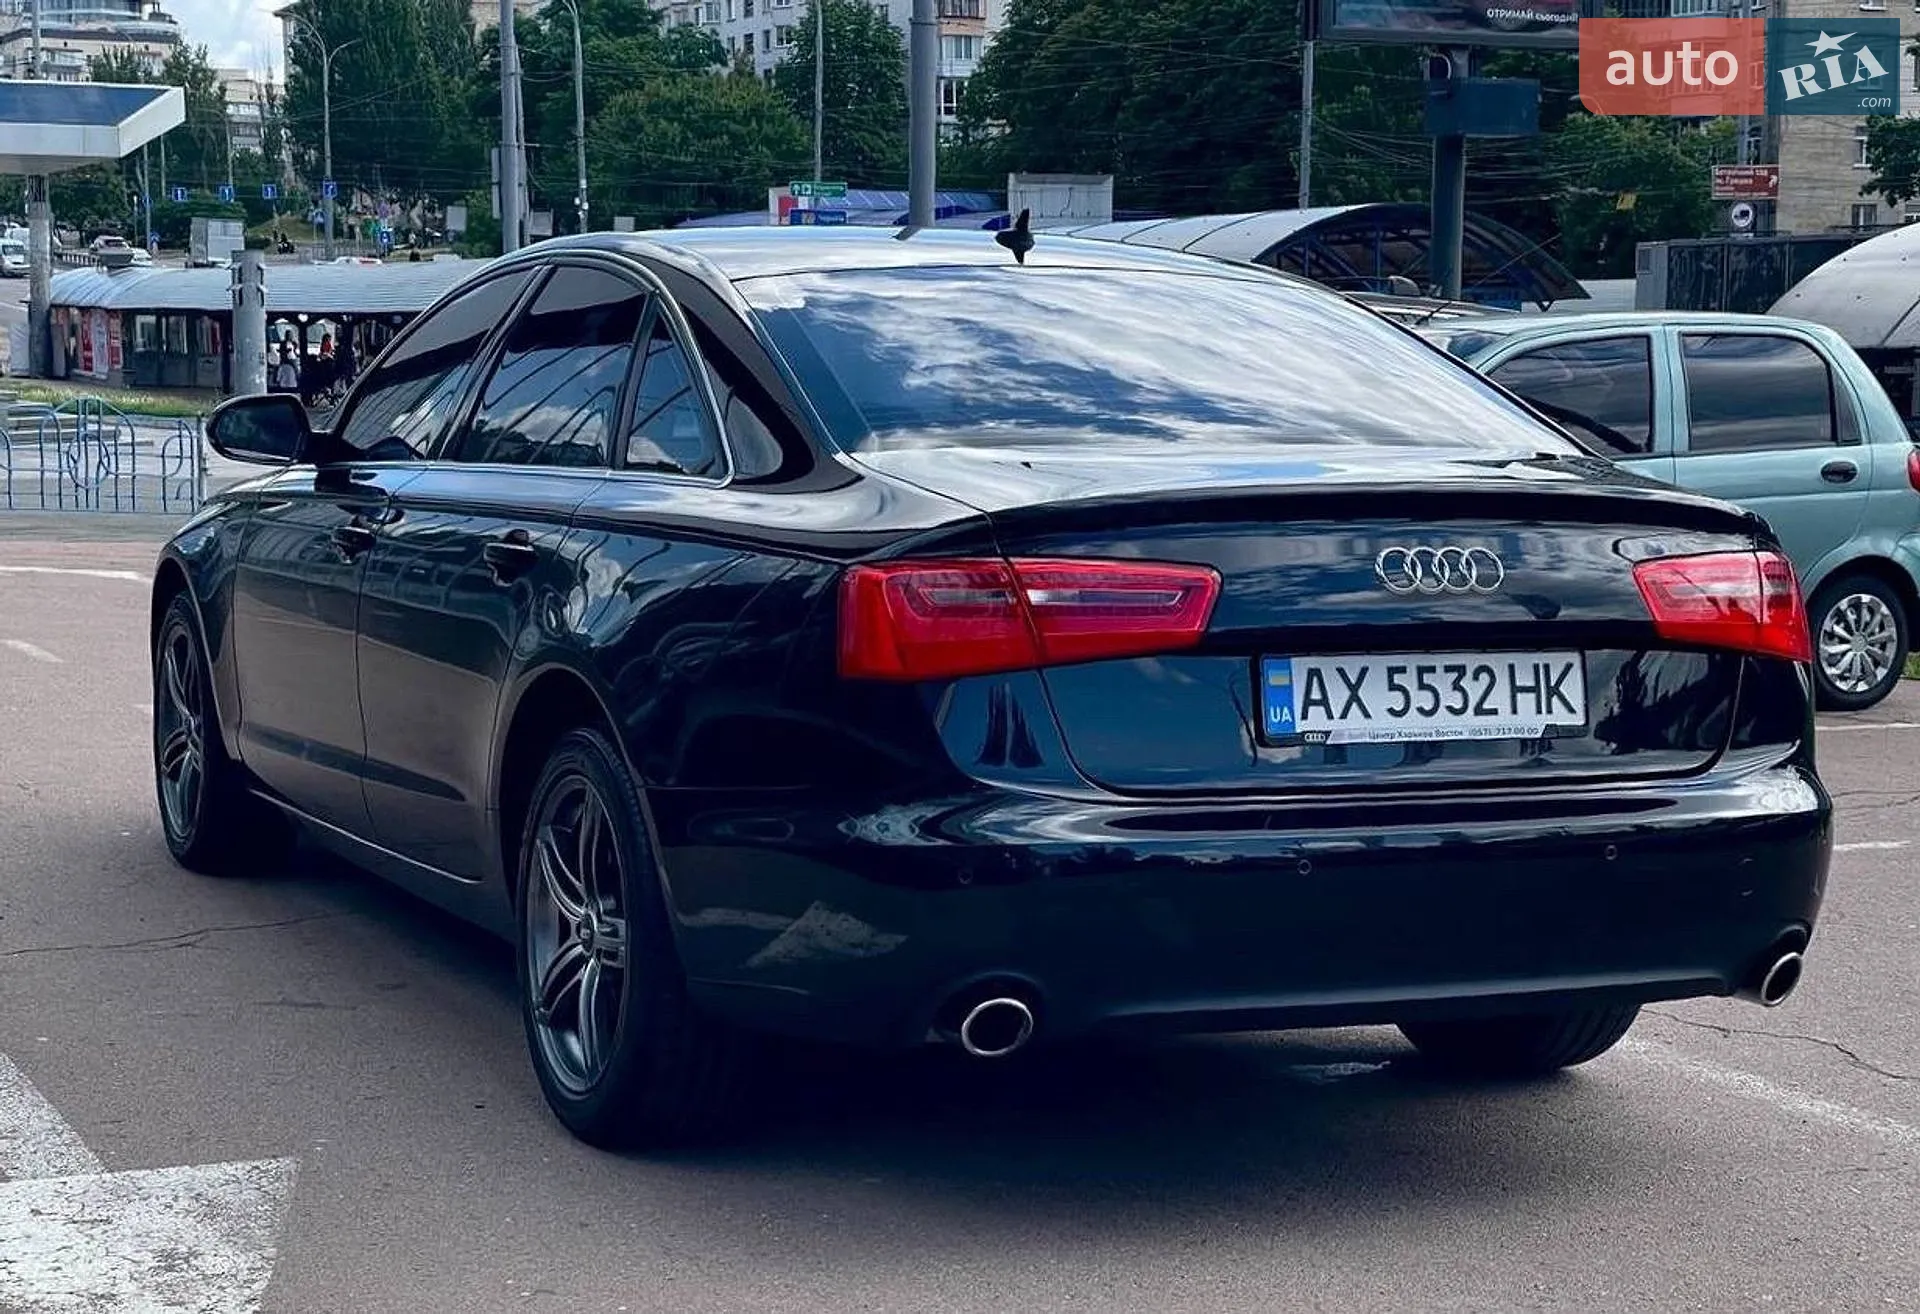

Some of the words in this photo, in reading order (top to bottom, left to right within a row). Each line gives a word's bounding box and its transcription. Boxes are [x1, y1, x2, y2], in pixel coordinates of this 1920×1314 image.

[1301, 666, 1372, 720] AX
[1386, 664, 1498, 718] 5532
[1508, 662, 1577, 715] HK
[1270, 706, 1293, 722] UA
